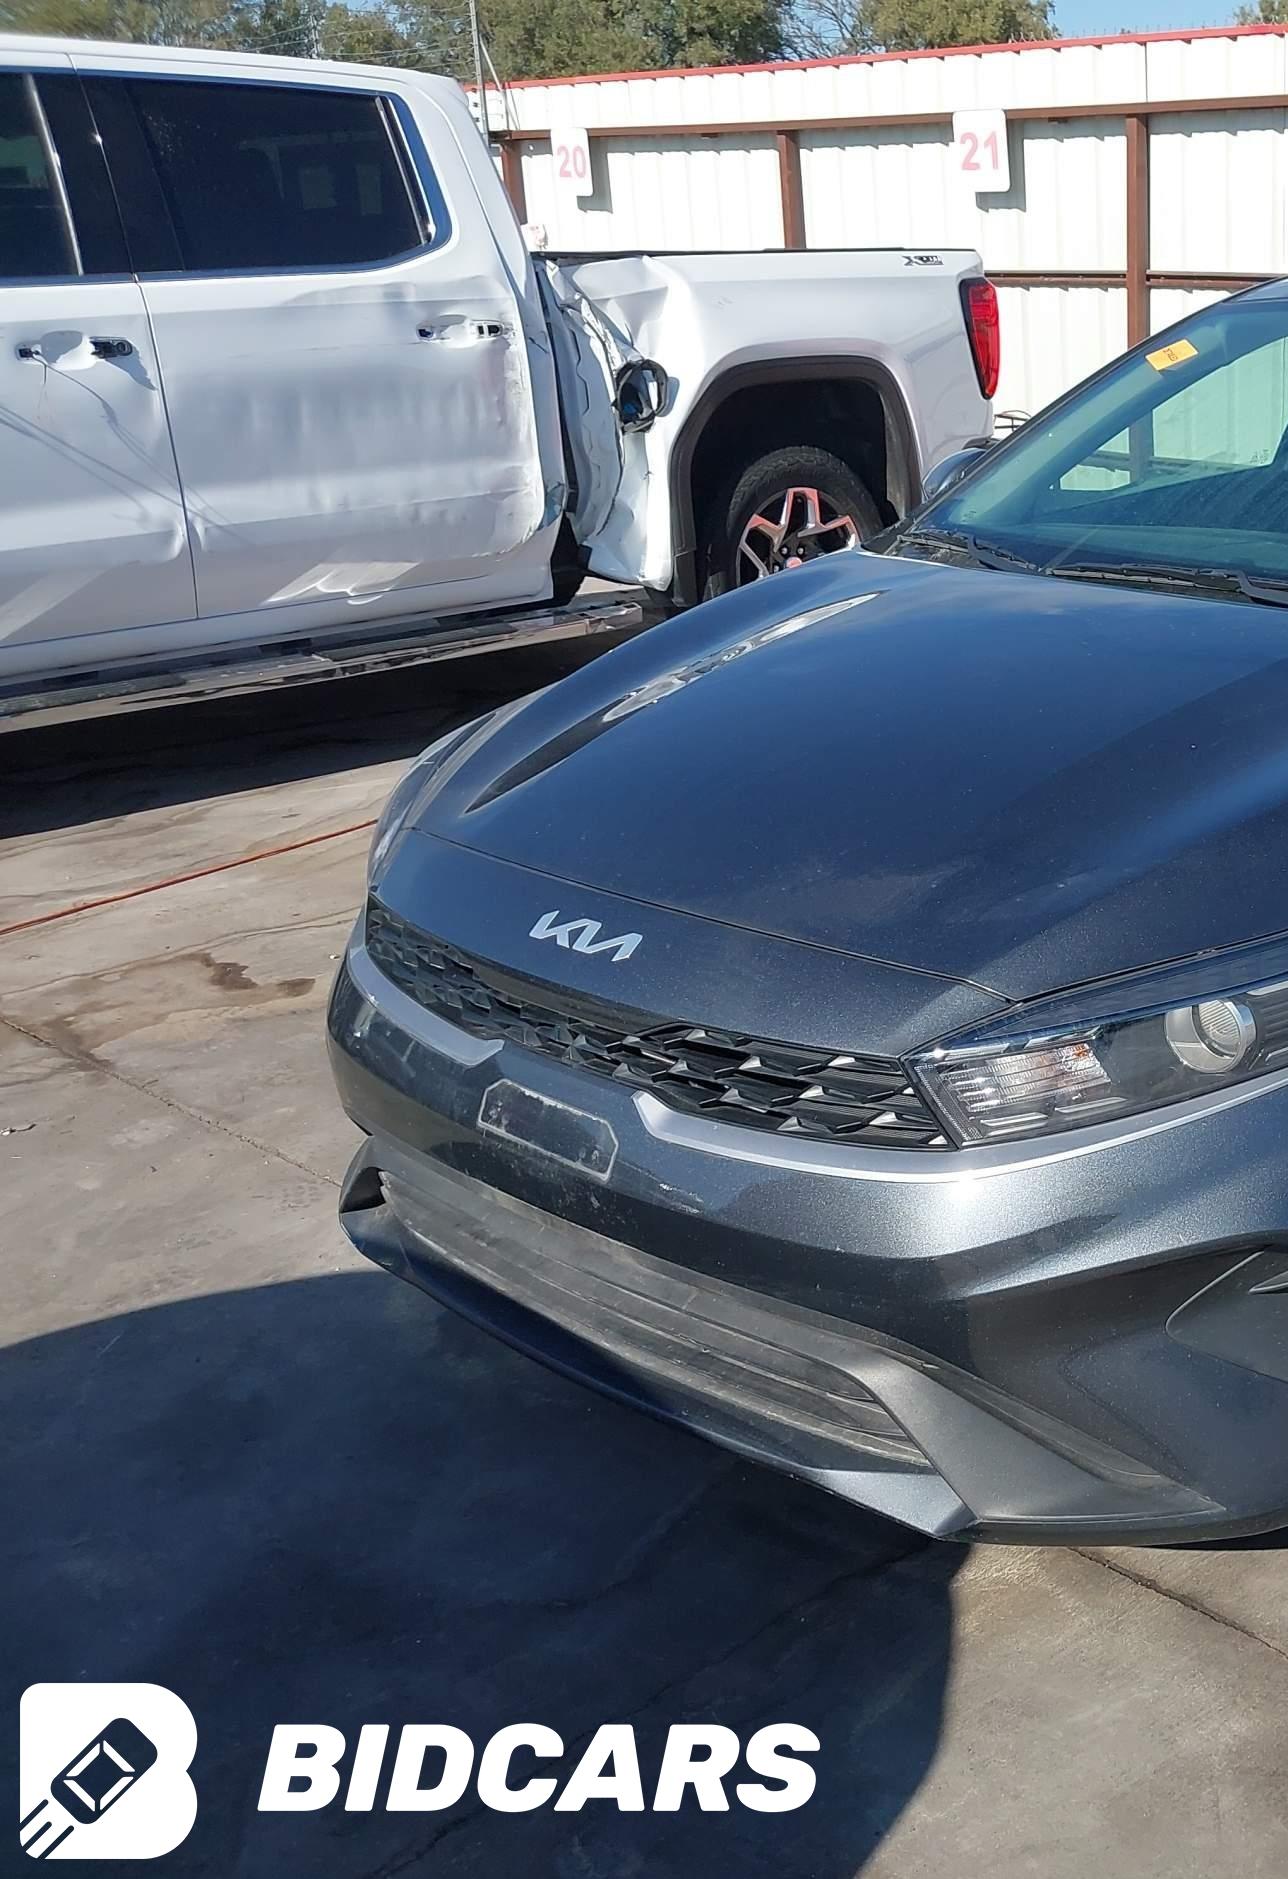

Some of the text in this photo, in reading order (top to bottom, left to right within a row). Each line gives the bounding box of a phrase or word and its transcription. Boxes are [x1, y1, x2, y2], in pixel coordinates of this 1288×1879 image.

[557, 144, 587, 178] 20
[960, 131, 1000, 171] 21
[528, 910, 643, 962] KIA
